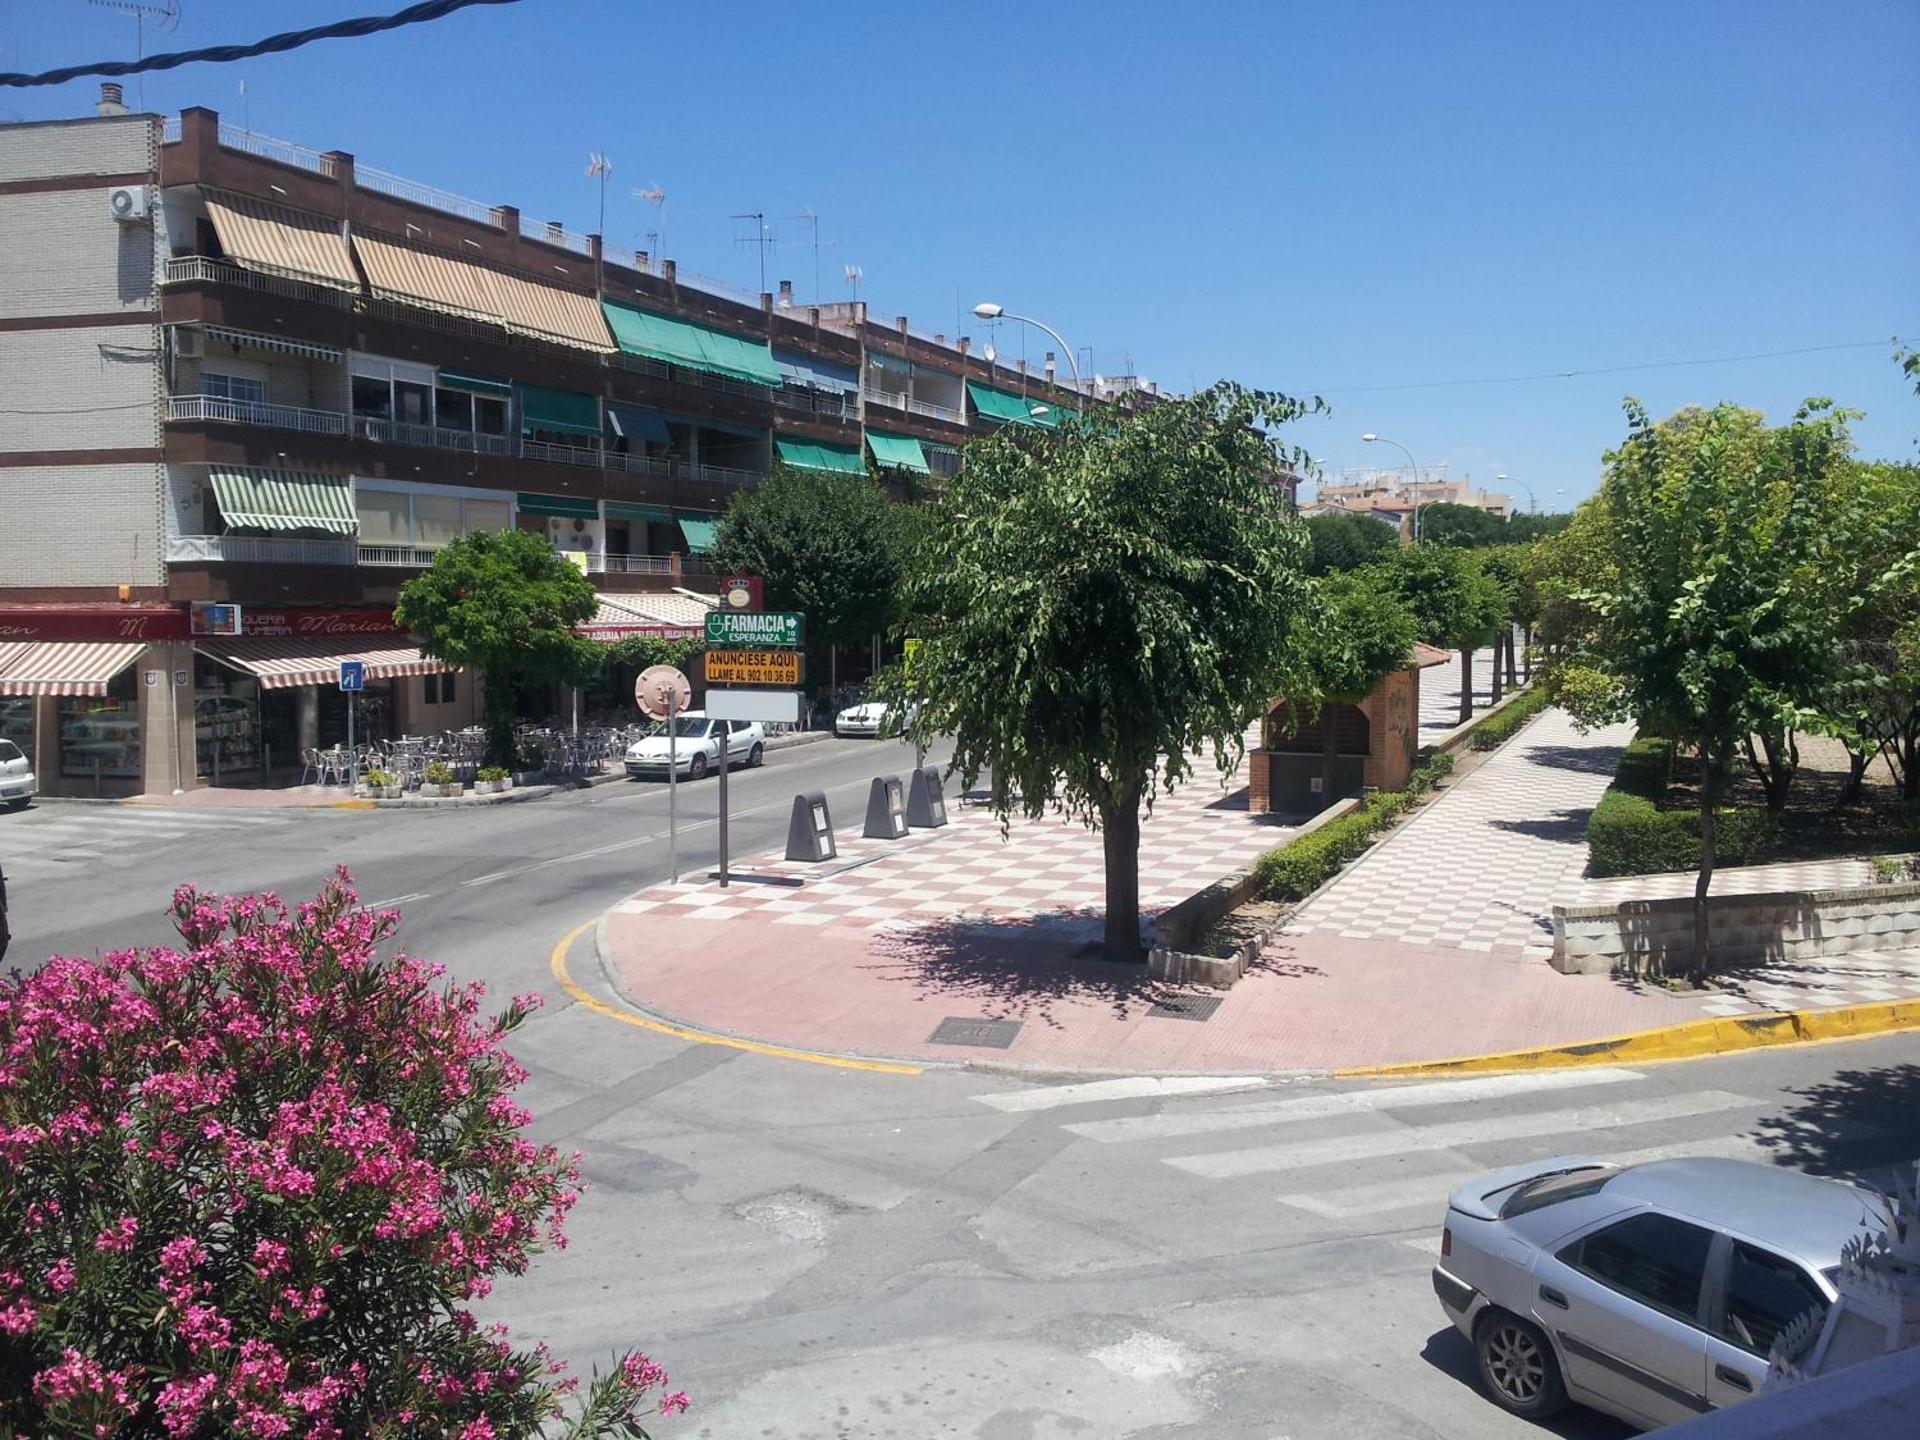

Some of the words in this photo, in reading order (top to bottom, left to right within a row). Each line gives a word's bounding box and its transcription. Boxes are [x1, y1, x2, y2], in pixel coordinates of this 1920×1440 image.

[725, 615, 785, 632] FARMACIA
[729, 633, 780, 642] ESPERANZA
[709, 653, 766, 666] ANUNCIESE
[769, 655, 795, 667] AQUI
[708, 668, 734, 680] LLAME
[736, 669, 745, 680] AL
[747, 669, 761, 681] 902
[764, 670, 772, 681] 10
[785, 670, 795, 682] 69
